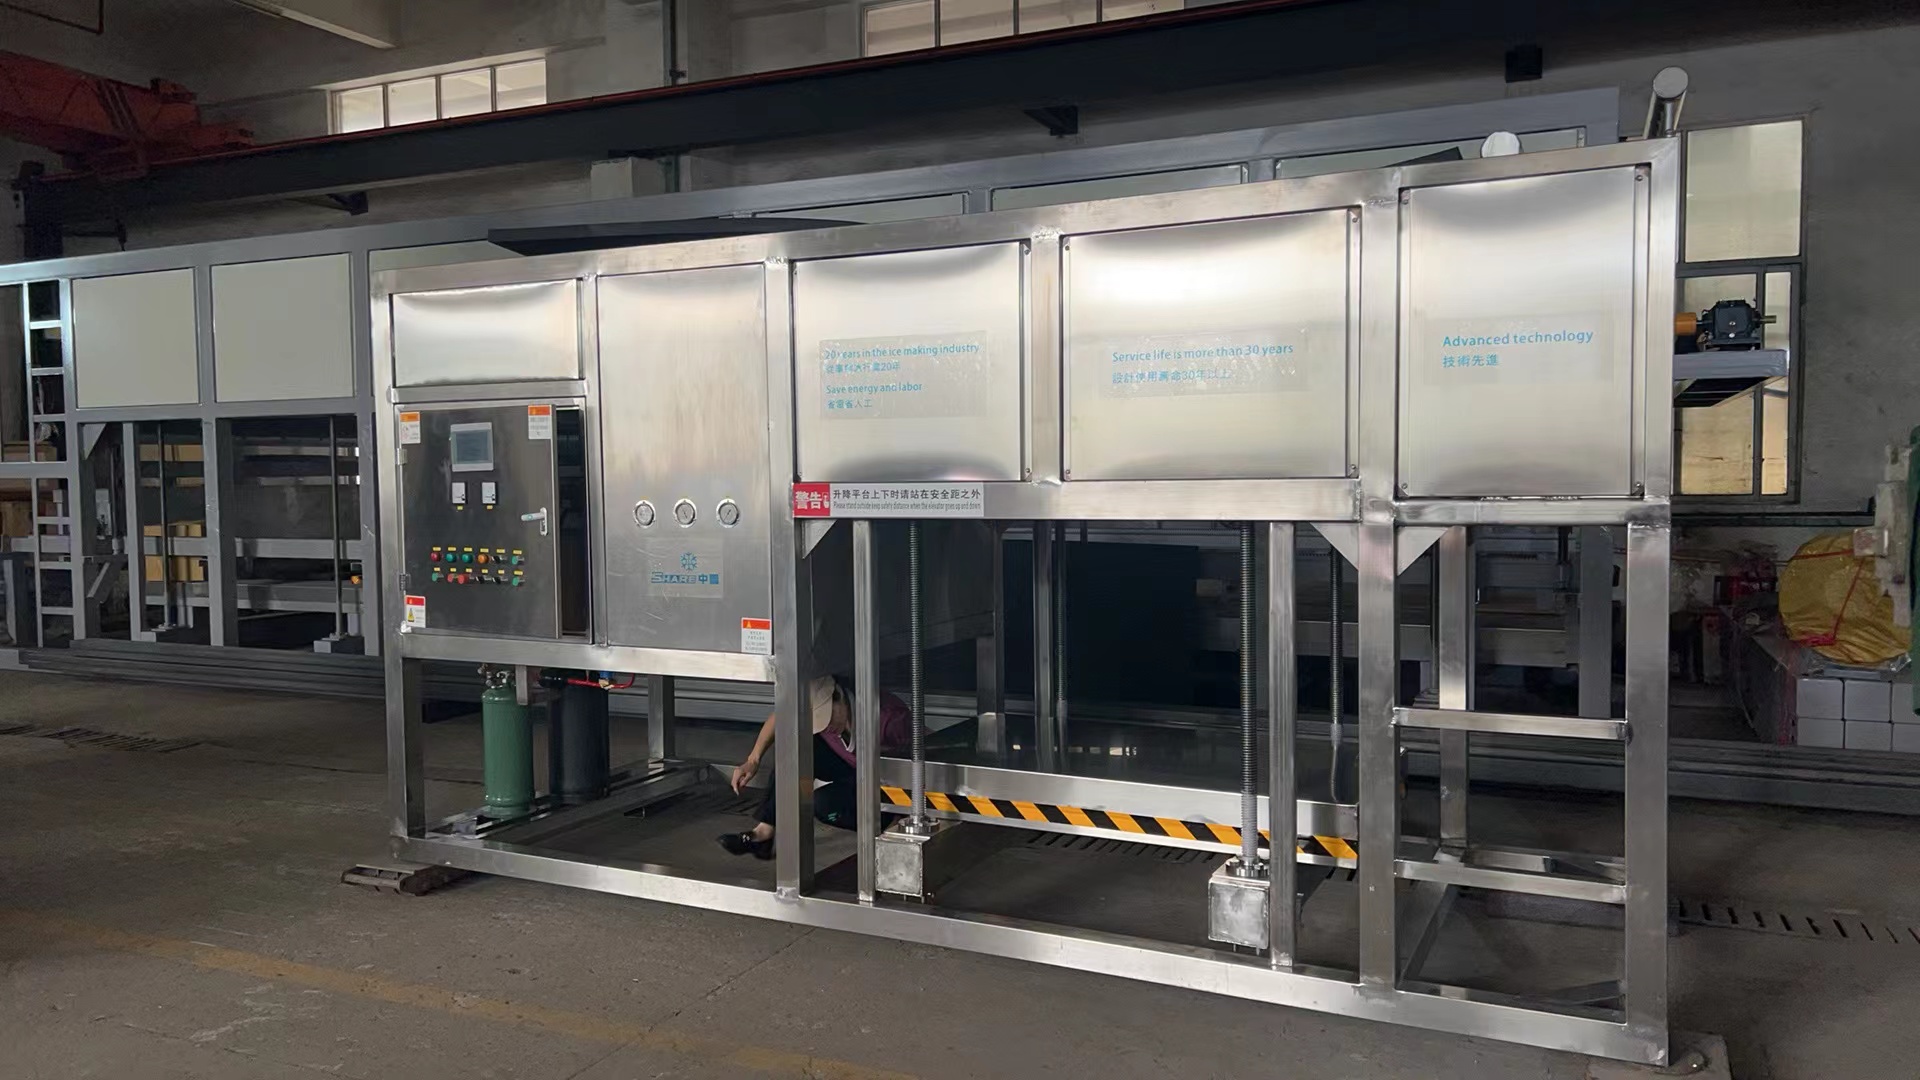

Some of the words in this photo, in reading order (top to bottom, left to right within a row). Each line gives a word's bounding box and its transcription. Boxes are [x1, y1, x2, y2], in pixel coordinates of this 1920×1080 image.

[1443, 333, 1510, 347] Advanced
[1513, 330, 1593, 344] technology
[862, 348, 871, 358] in
[872, 347, 887, 357] the
[889, 347, 901, 357] ice
[903, 345, 938, 357] making
[939, 343, 979, 355] industry
[1112, 351, 1151, 363] Service
[1153, 349, 1171, 361] life
[1173, 349, 1182, 359] is
[1184, 348, 1214, 359] more
[1216, 346, 1242, 357] than
[1245, 345, 1259, 355] 30
[1262, 343, 1293, 356] years
[1443, 353, 1499, 368] 技術先進
[826, 385, 846, 395] Save
[847, 383, 878, 396] energy
[899, 381, 922, 392] labor
[795, 491, 822, 509] 警告
[833, 489, 981, 499] 升降平台上下时请站在安全距之外
[651, 571, 696, 584] SHARE
